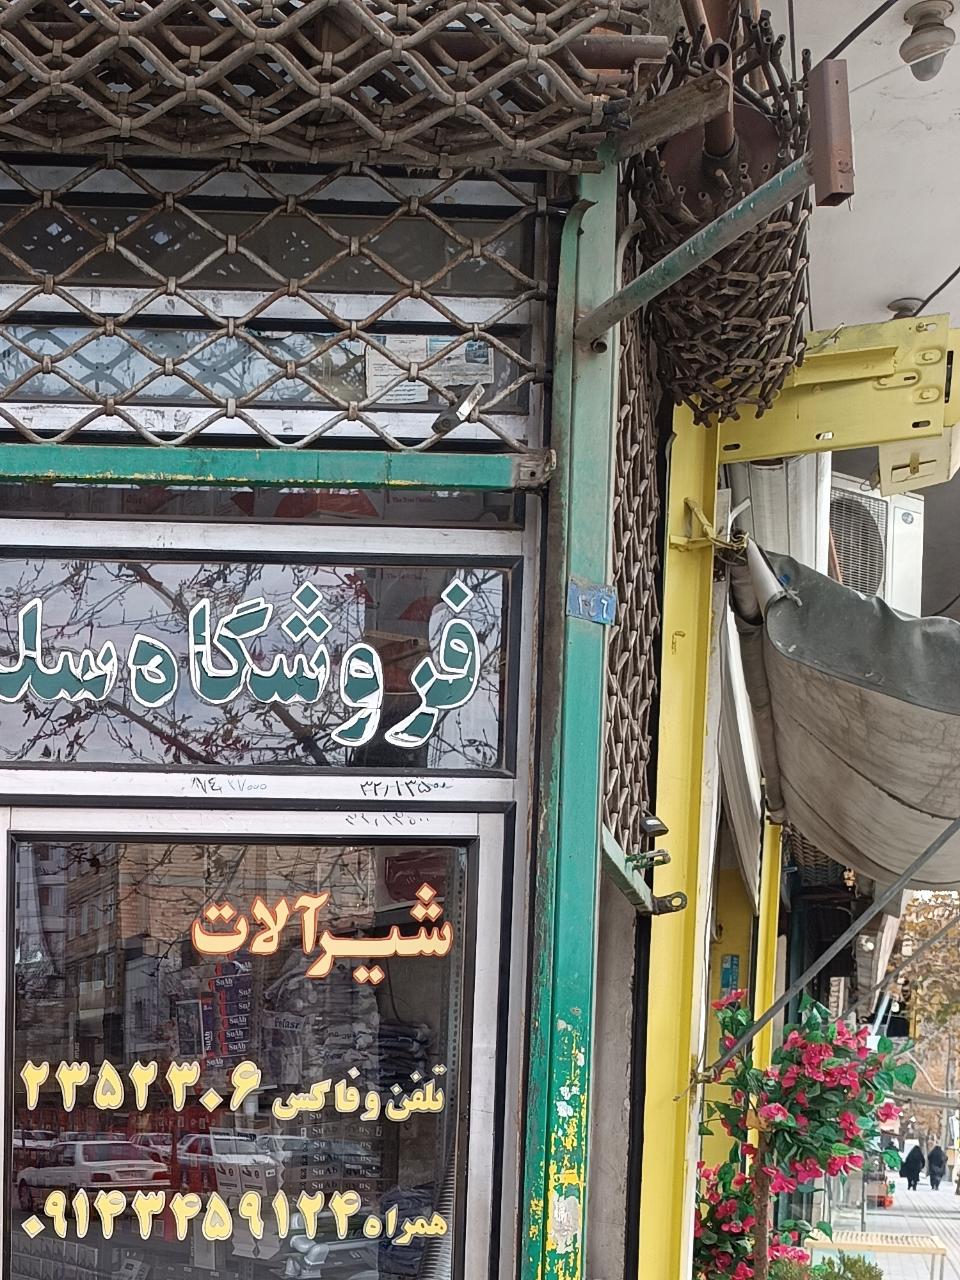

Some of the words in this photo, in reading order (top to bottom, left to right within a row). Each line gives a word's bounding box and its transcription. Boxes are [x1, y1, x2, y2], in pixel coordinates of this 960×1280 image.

[131, 576, 484, 748] فروشگاه
[20, 1059, 262, 1114] ۲۳۵۲۳۰۶
[272, 1066, 360, 1121] فاکس
[385, 1063, 447, 1122] تلفن
[20, 1188, 362, 1241] ۰۹۱۴۳۴۵۹۱۲۴
[363, 1203, 448, 1246] همراه
